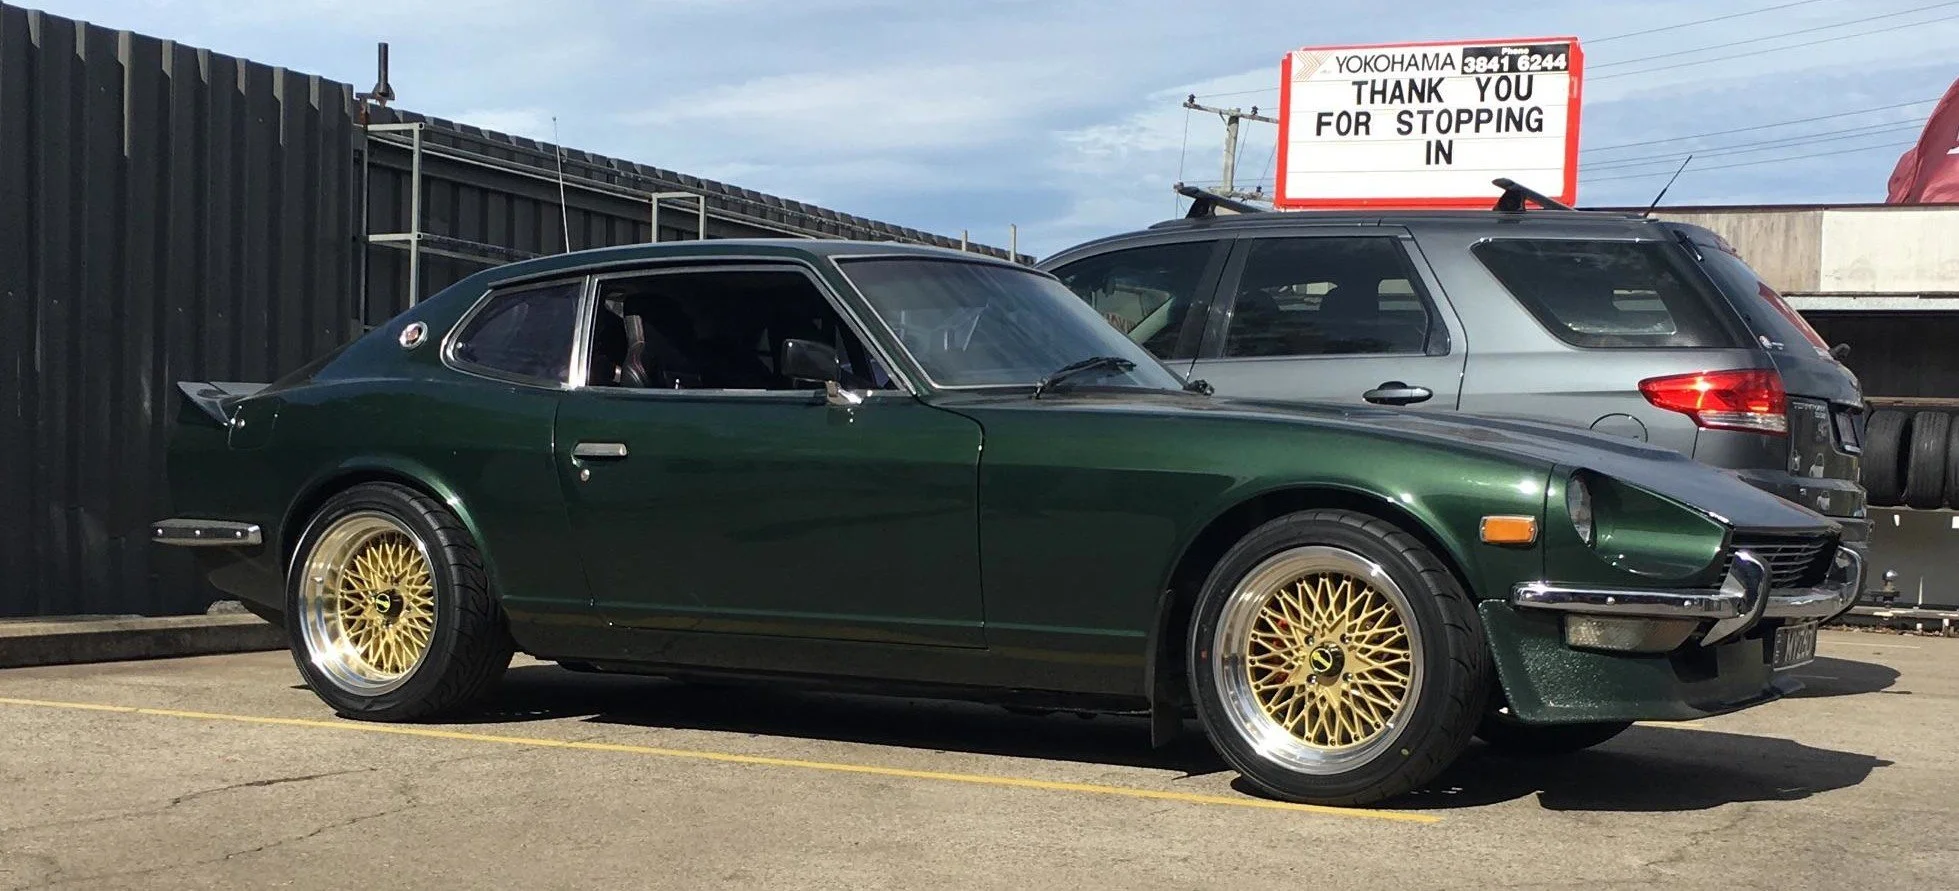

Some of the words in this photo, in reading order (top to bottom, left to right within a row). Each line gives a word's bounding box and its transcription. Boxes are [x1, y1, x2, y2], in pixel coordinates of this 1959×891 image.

[1335, 52, 1456, 74] YOKOHAMA
[1463, 56, 1509, 73] 3841
[1517, 53, 1567, 71] 6244
[1501, 47, 1530, 55] Phone
[1352, 77, 1444, 105] THANK
[1475, 75, 1534, 102] YOU
[1316, 111, 1371, 136] FOR
[1396, 106, 1543, 135] STOPPING
[1425, 139, 1453, 165] IN
